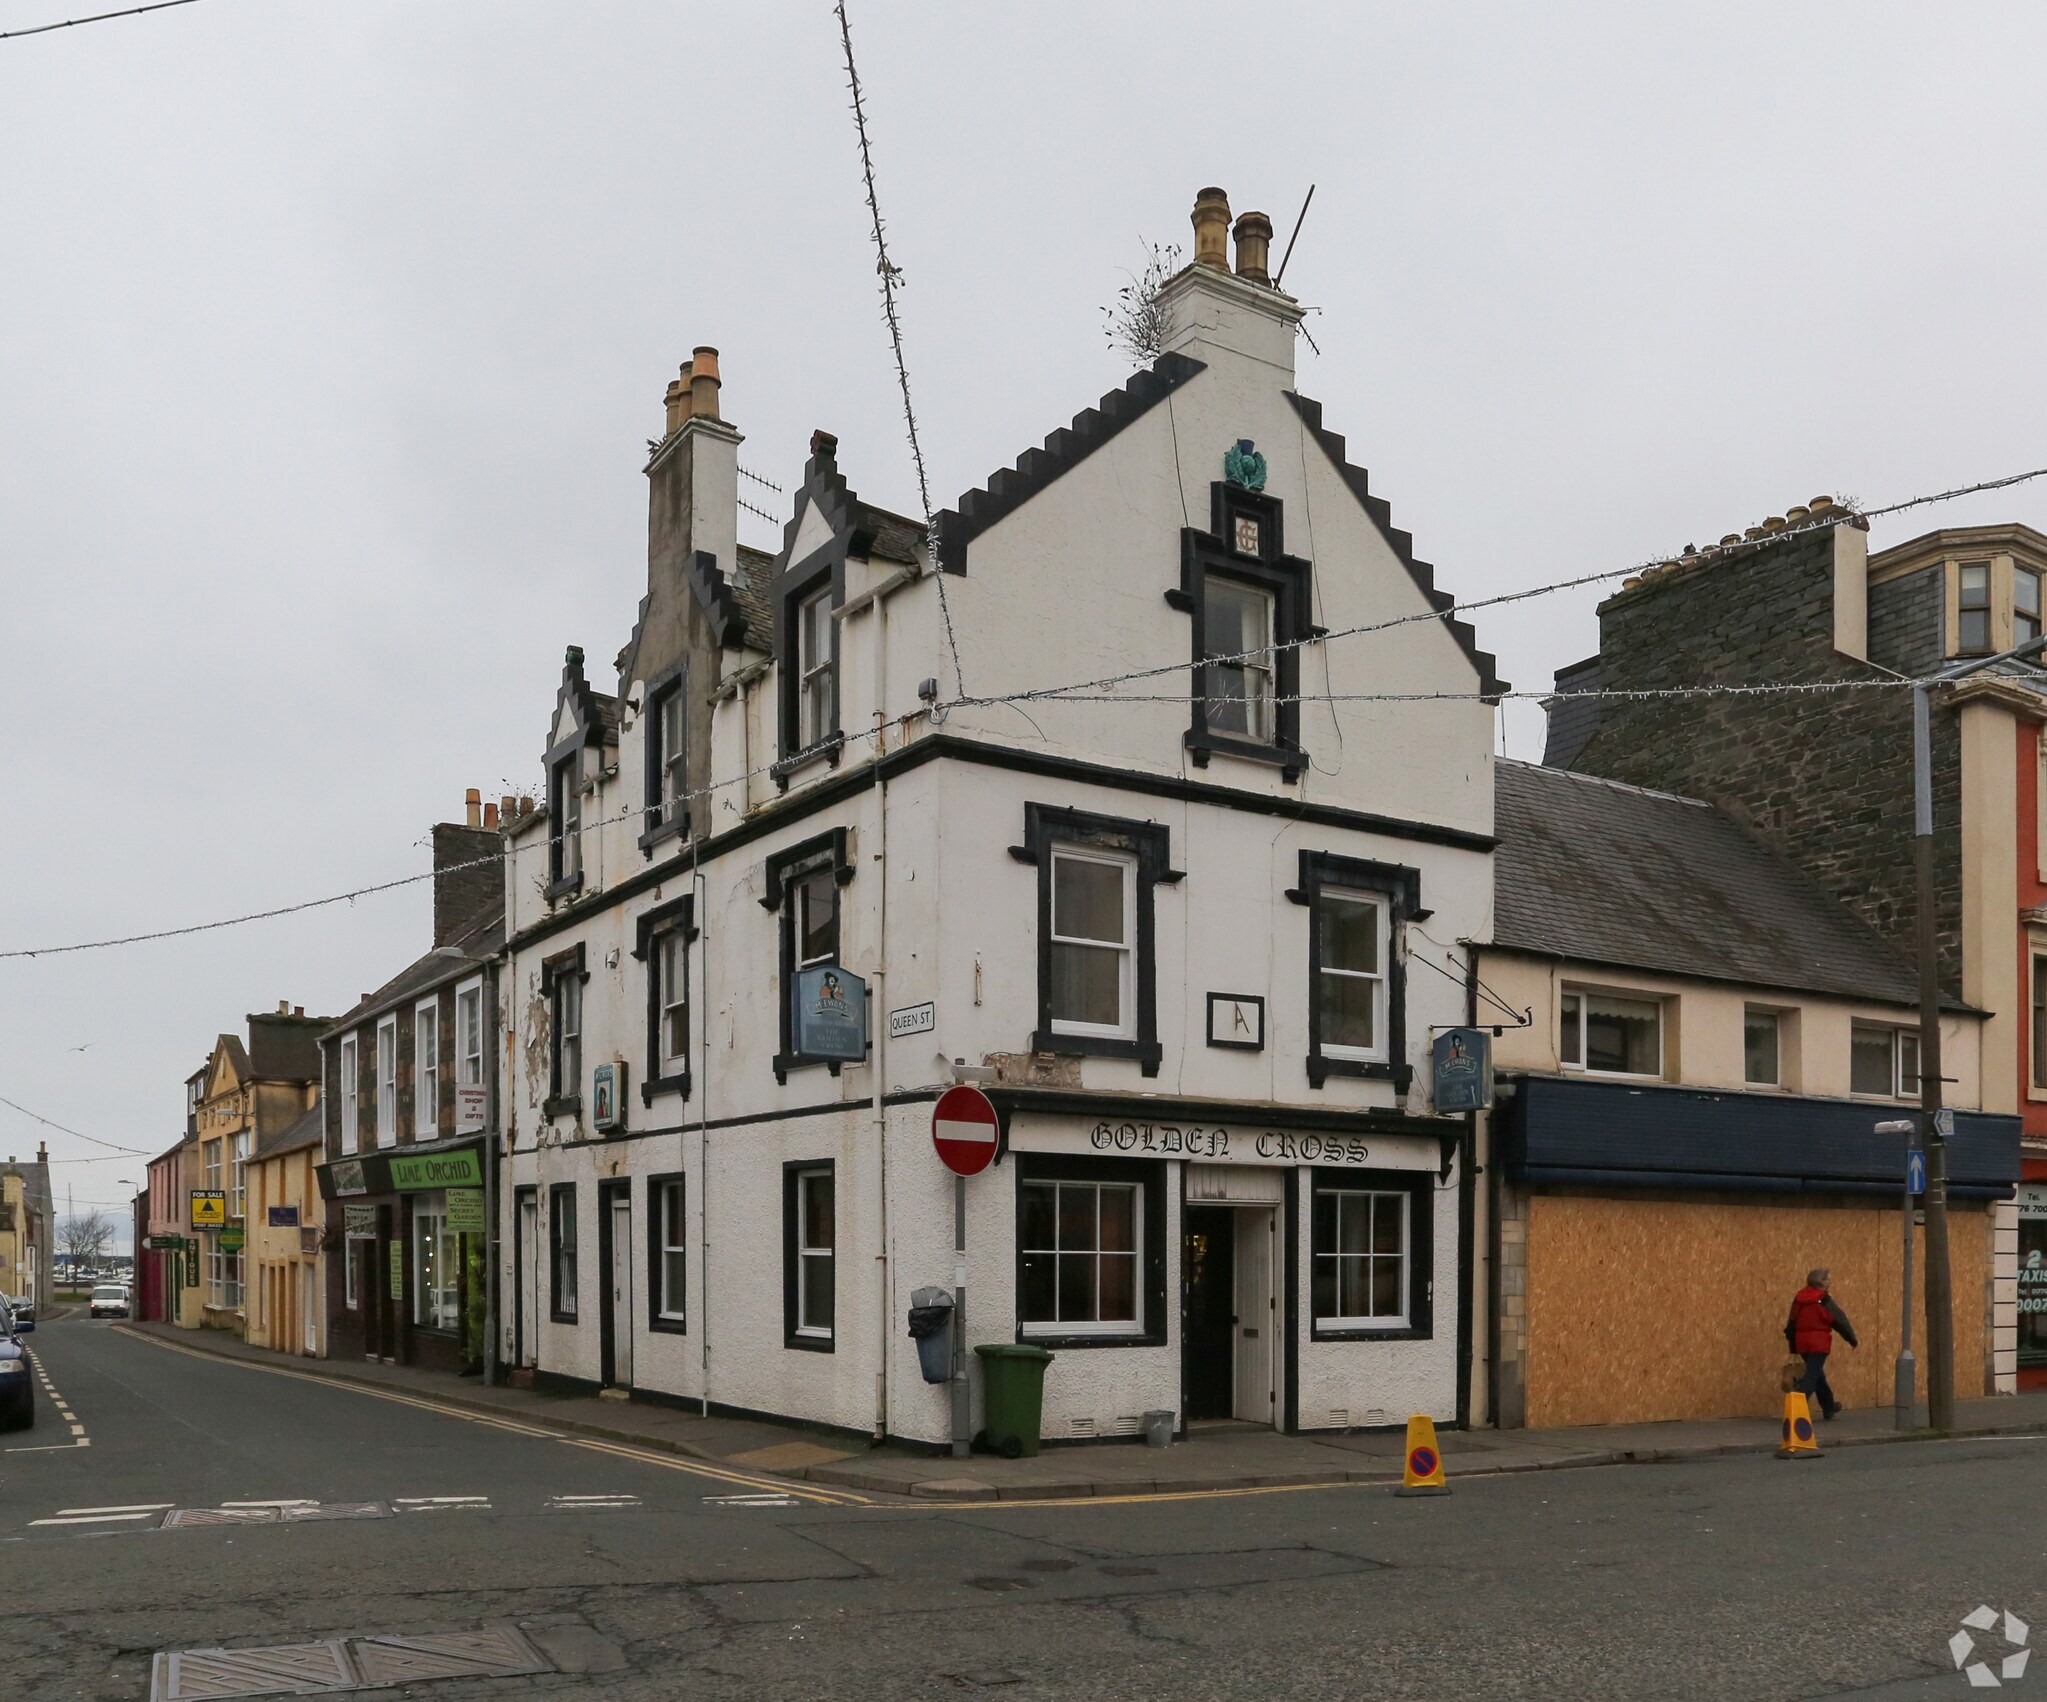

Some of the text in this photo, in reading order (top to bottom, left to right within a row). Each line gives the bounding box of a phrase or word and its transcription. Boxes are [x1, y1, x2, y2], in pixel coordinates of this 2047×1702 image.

[893, 1013, 918, 1030] QUEEN
[1090, 1122, 1369, 1163] GOLDEN CROSS
[397, 1160, 471, 1182] LIME ORCHID
